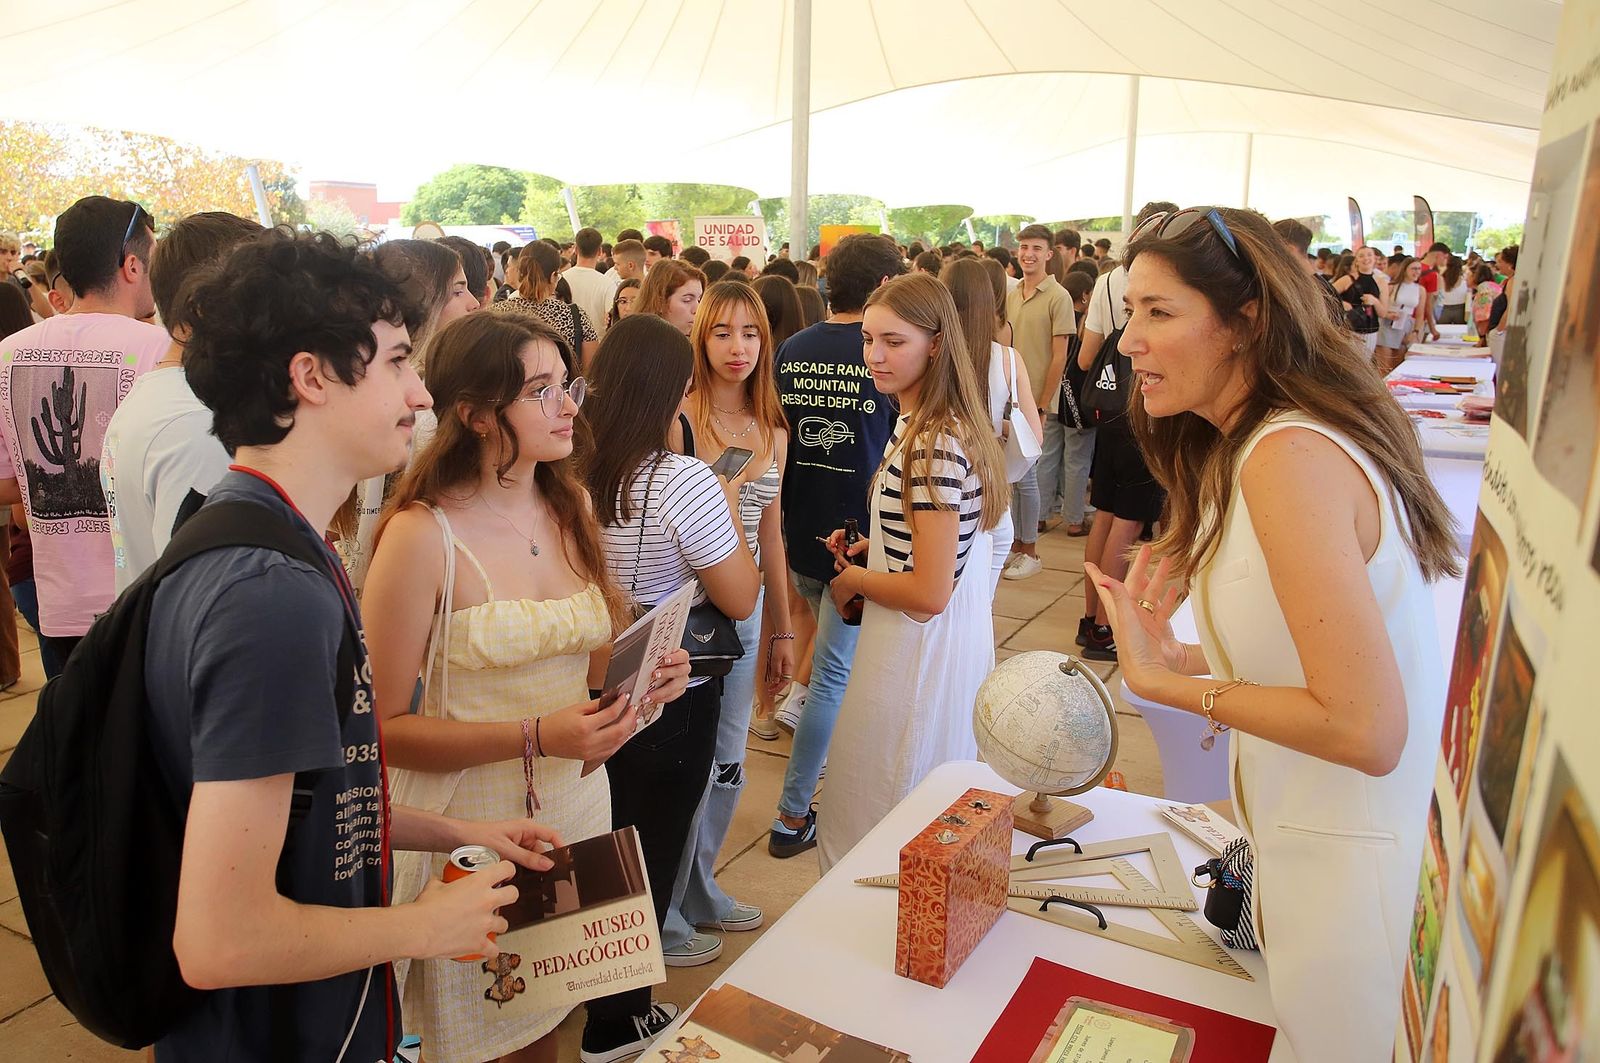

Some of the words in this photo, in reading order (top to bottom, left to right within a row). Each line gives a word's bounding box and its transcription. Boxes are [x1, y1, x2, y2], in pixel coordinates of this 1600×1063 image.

[703, 224, 755, 235] UNIDAD
[698, 236, 716, 247] DE
[718, 235, 761, 247] SALUD
[13, 349, 72, 363] DESERT
[72, 350, 124, 365] RIDER
[780, 361, 835, 376] CASCADE
[793, 377, 861, 394] MOUNTAIN
[781, 393, 826, 408] RESCUE
[827, 396, 862, 411] DEPT.
[74, 519, 111, 533] SERT
[353, 689, 372, 715] &
[582, 909, 645, 941] MUSEO
[532, 933, 650, 979] PEDAGÓGICO
[565, 968, 612, 993] Universidad
[623, 961, 654, 979] Huelva
